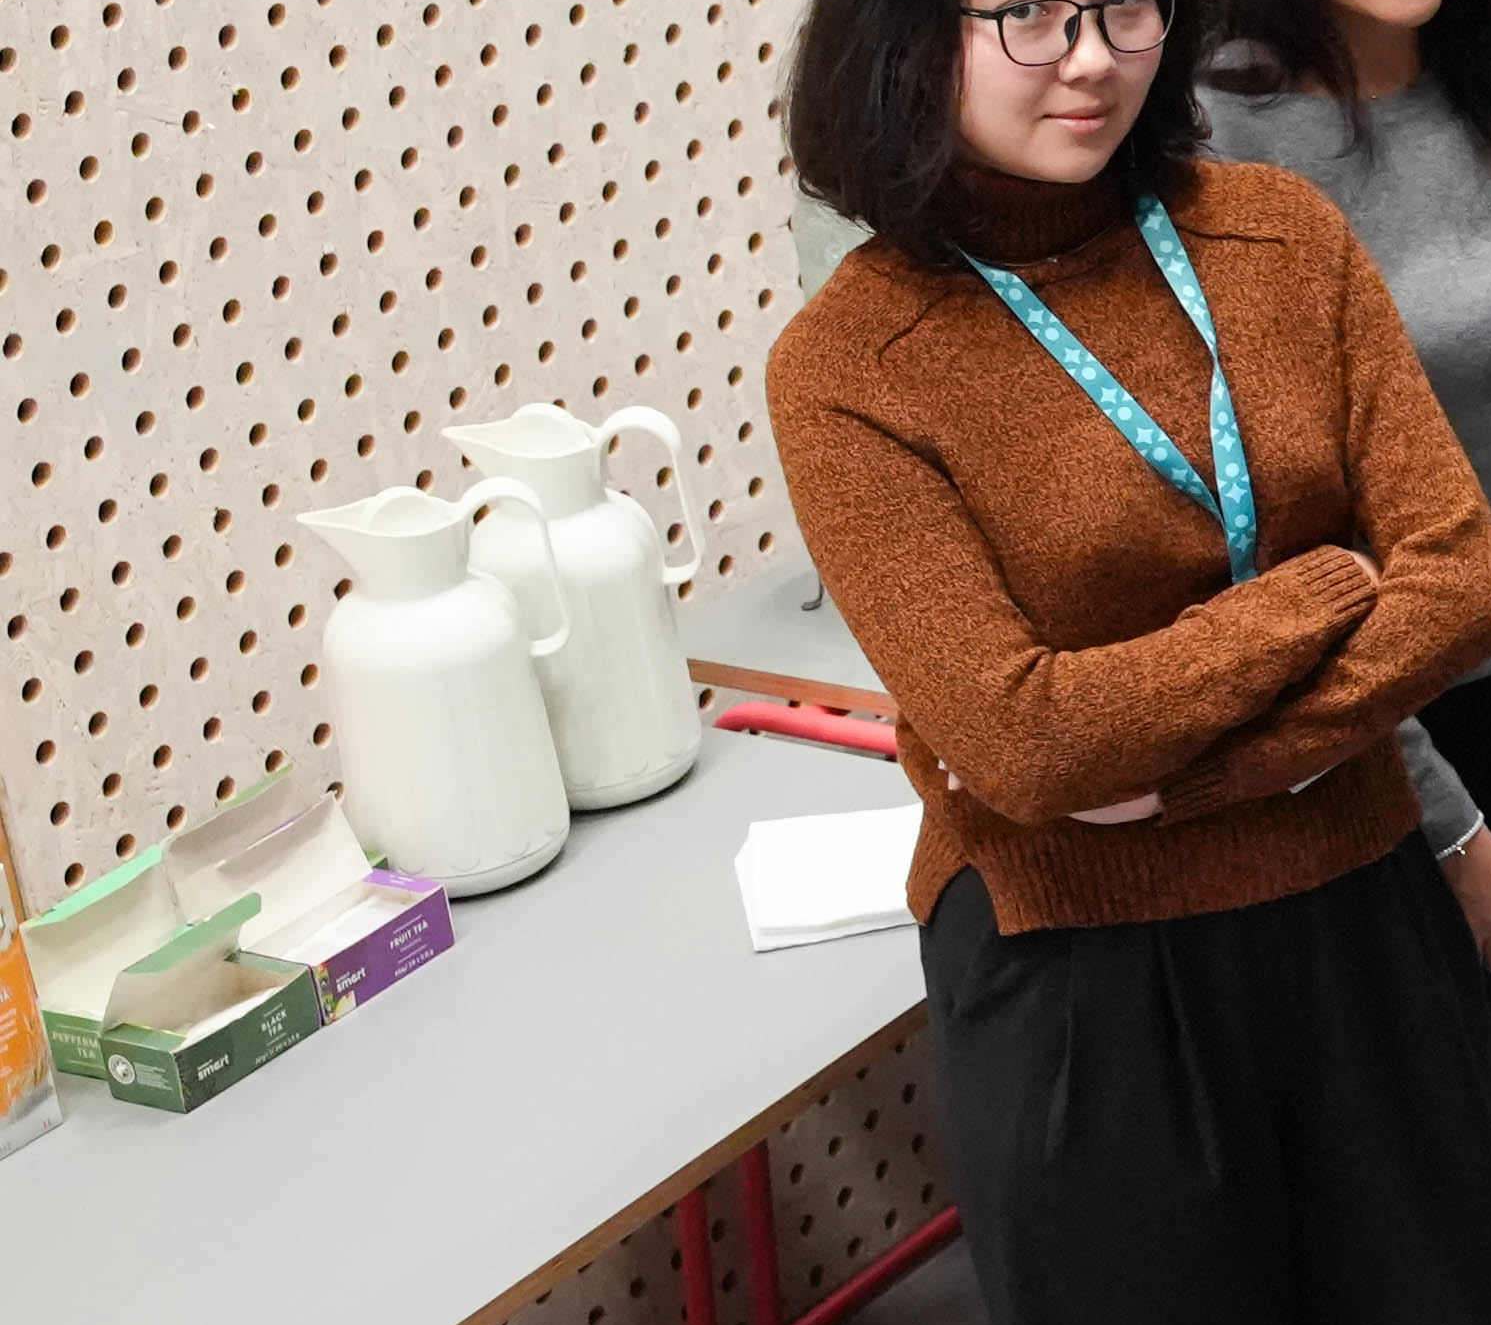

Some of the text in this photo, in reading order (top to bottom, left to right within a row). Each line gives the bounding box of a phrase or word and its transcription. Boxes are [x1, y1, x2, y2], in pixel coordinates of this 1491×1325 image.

[390, 920, 429, 950] FRUIT TEA
[336, 967, 367, 994] smart
[261, 1010, 288, 1033] BLACK
[268, 1024, 283, 1037] TEA
[77, 1048, 96, 1060] TEA
[198, 1054, 230, 1081] smart
